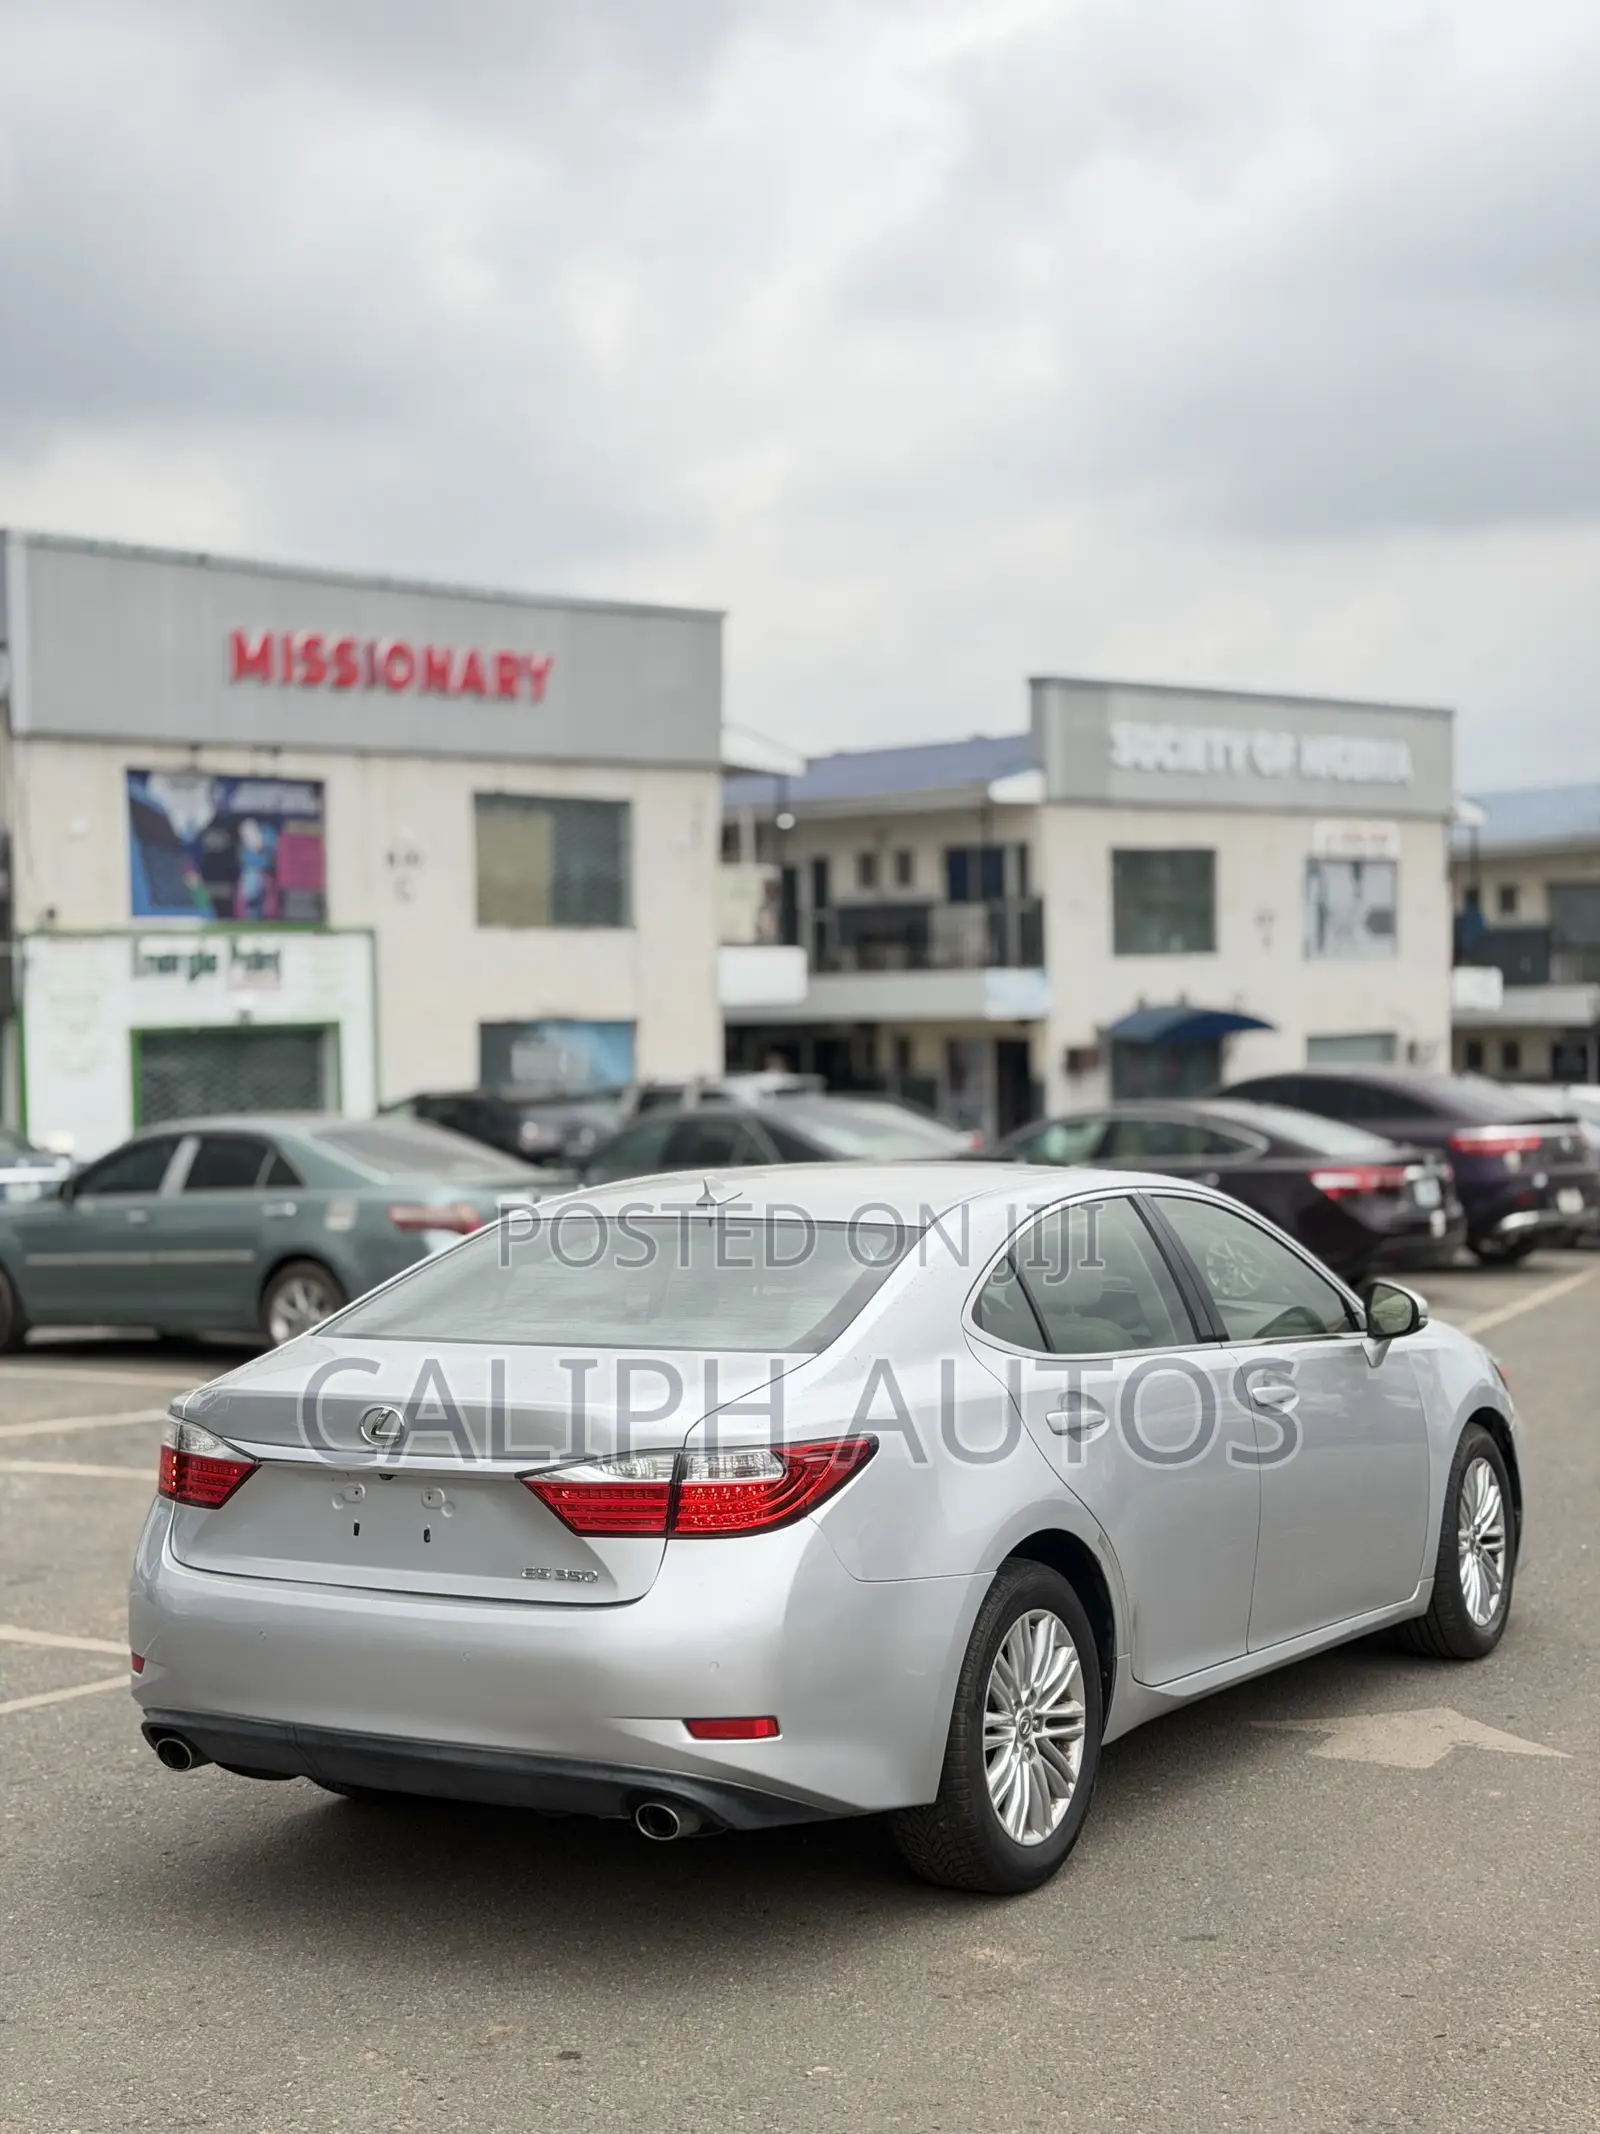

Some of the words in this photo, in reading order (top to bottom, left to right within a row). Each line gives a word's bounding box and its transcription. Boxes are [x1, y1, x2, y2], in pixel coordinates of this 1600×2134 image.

[229, 628, 553, 705] MISSIONARY
[521, 1566, 551, 1580] ES
[555, 1568, 598, 1583] 350
